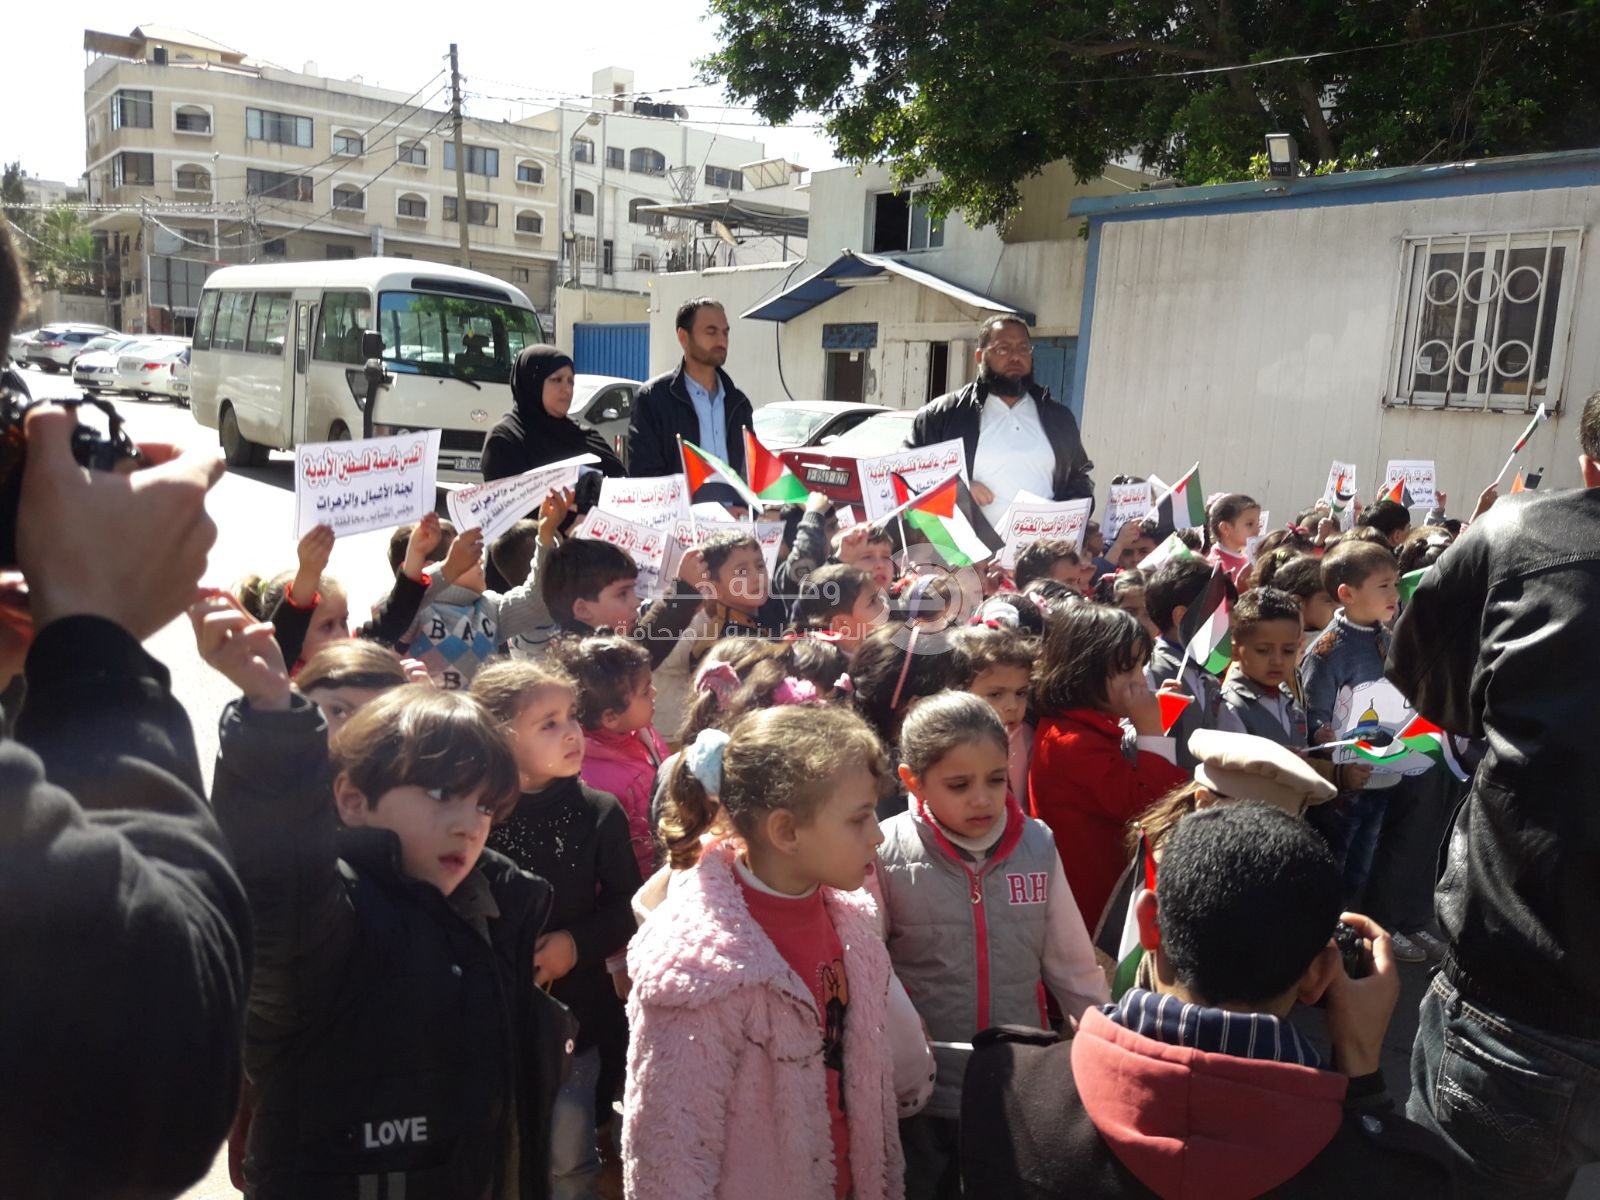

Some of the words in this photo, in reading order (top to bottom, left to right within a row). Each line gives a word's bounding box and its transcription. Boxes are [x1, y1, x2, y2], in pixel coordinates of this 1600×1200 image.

[394, 482, 414, 499] لجنة
[316, 493, 359, 513] والزهرات
[429, 618, 446, 640] B
[462, 621, 474, 641] A
[481, 617, 494, 638] C
[442, 671, 462, 690] B
[1006, 872, 1048, 905] RH
[364, 1116, 428, 1149] LOVE
